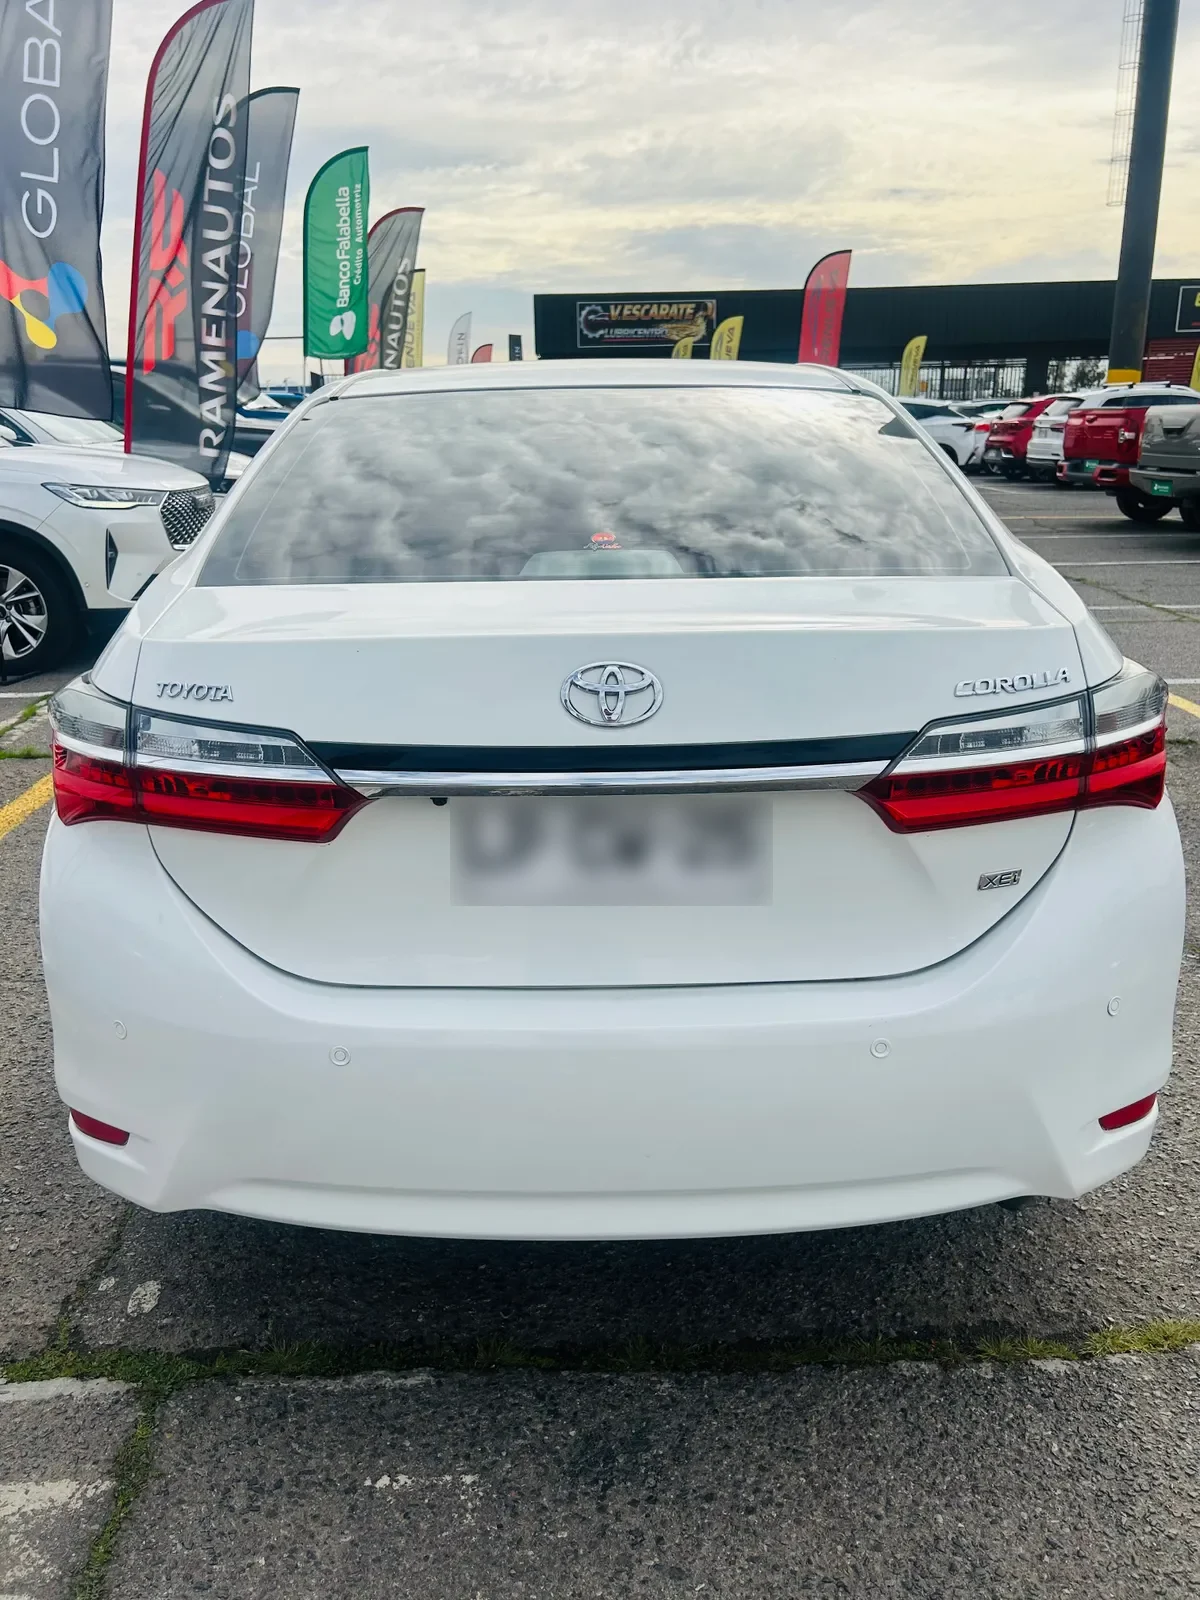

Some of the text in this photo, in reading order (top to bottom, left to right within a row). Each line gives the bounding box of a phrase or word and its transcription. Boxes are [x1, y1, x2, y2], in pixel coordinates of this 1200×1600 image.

[353, 183, 363, 285] Crédito Automotriz
[199, 93, 237, 458] RAMENAUTOS
[157, 682, 234, 702] TOYOTA
[954, 667, 1070, 697] COROLLA
